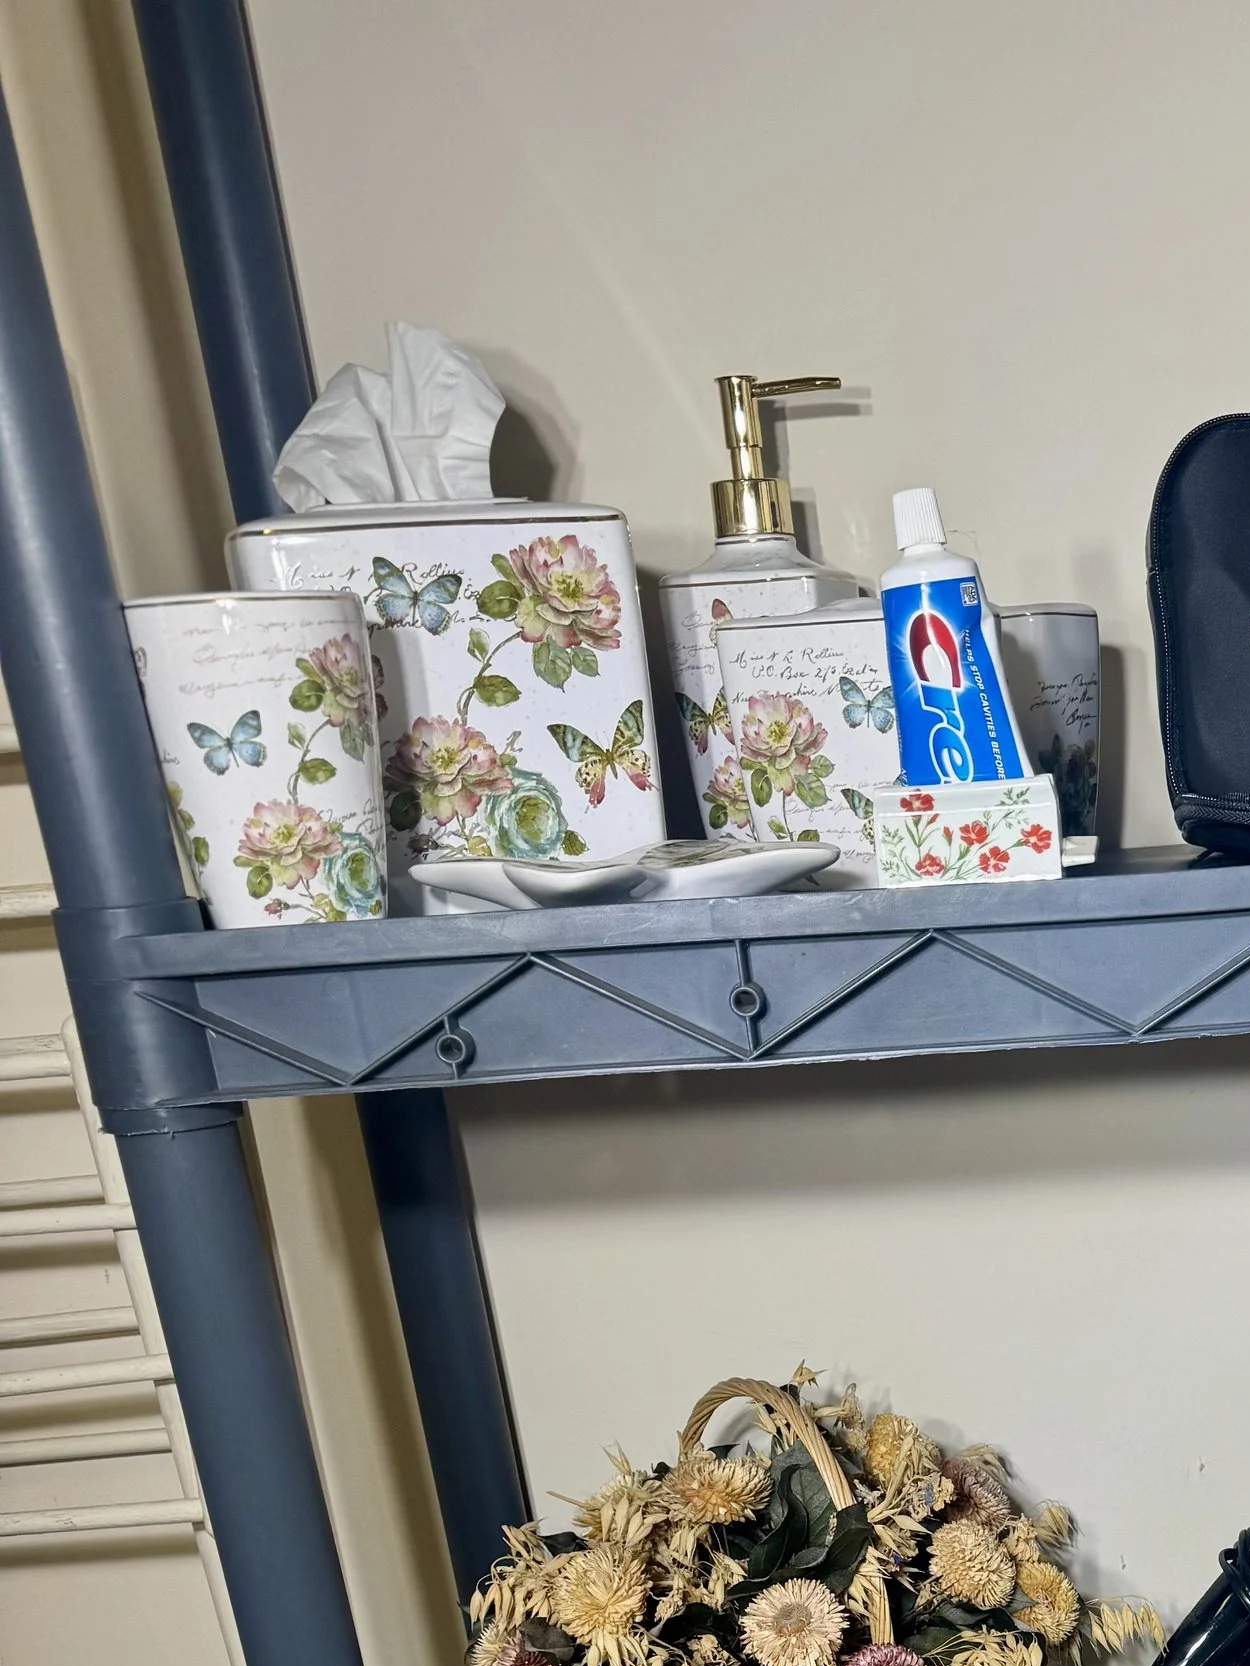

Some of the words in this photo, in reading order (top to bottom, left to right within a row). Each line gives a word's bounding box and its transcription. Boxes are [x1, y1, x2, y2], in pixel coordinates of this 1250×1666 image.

[906, 609, 974, 785] Cre
[969, 665, 985, 692] STOP
[979, 693, 997, 738] CAVITIES
[991, 741, 1007, 780] BEFORE
